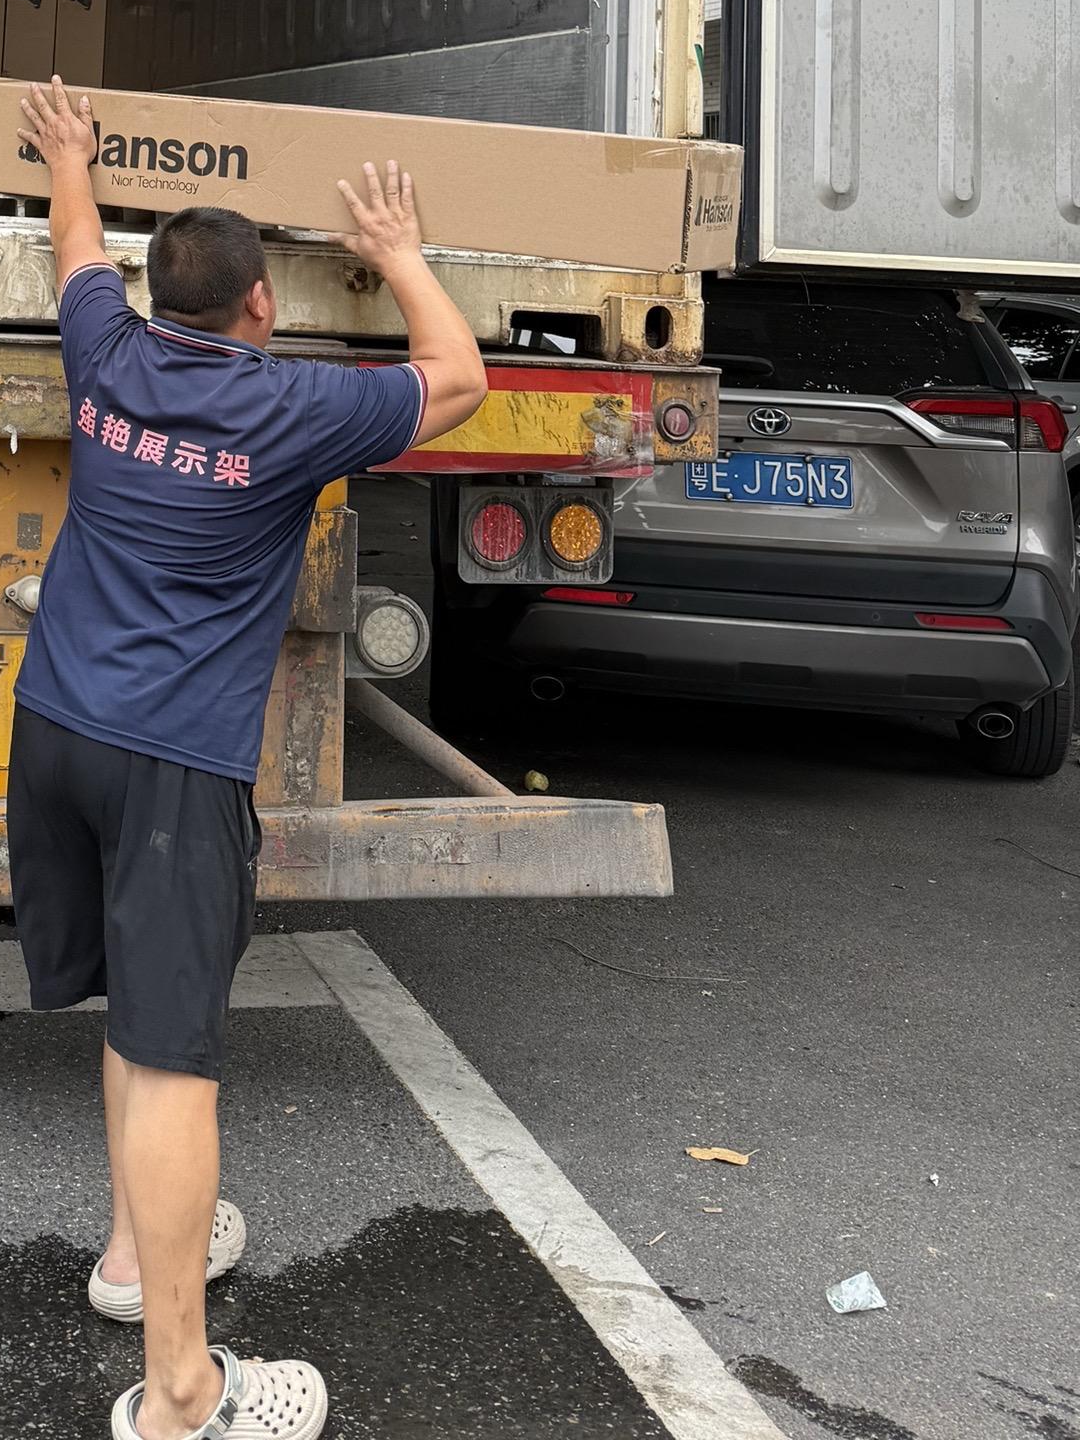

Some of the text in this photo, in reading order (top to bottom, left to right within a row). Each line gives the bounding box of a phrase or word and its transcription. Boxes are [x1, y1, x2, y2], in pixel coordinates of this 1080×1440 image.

[136, 175, 200, 195] Technology
[77, 397, 251, 487] 强艳展示架
